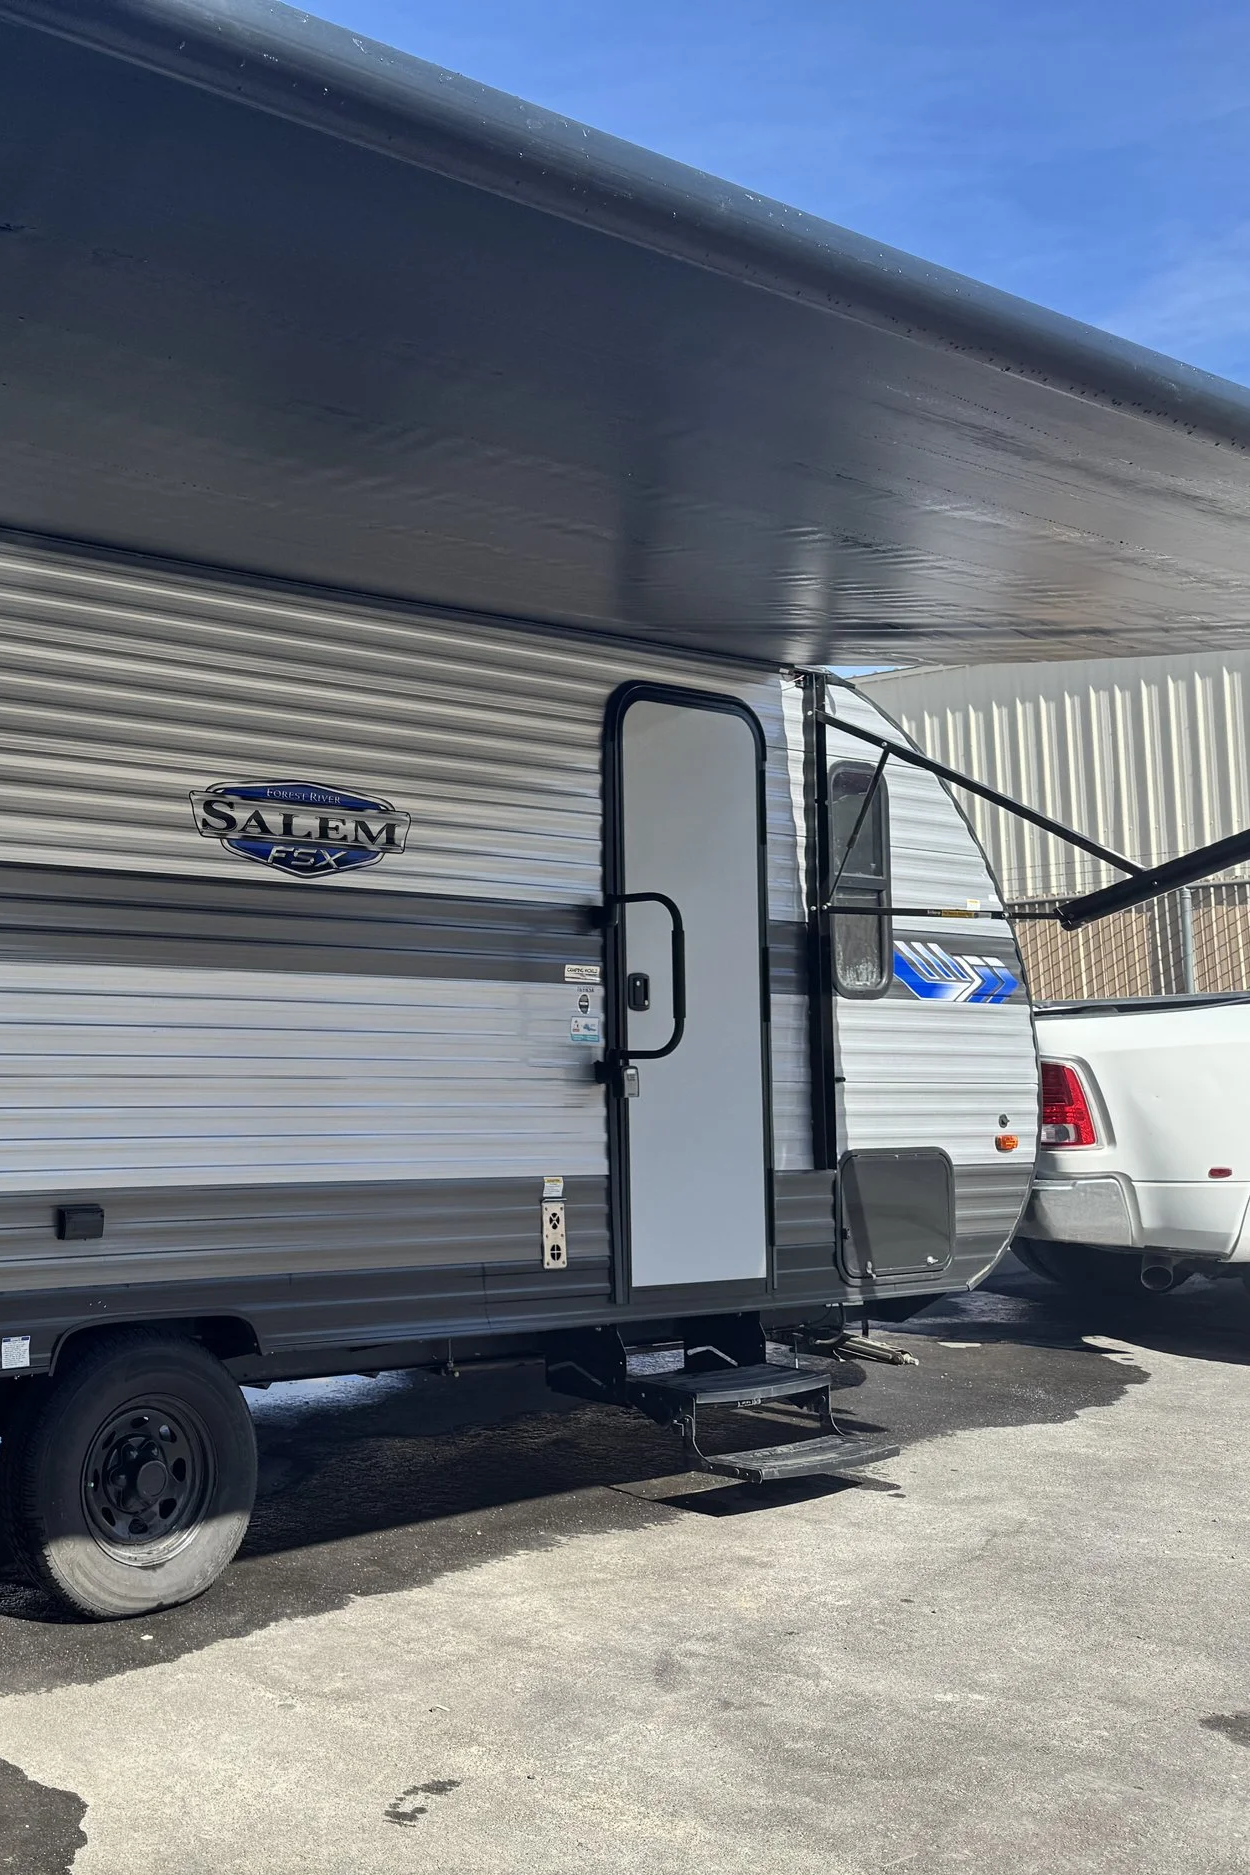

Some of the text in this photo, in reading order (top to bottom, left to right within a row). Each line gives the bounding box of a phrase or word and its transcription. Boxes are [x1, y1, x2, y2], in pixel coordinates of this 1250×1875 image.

[266, 788, 341, 804] FOREST RIVER
[201, 799, 398, 846] SALEM
[267, 845, 347, 869] FSX
